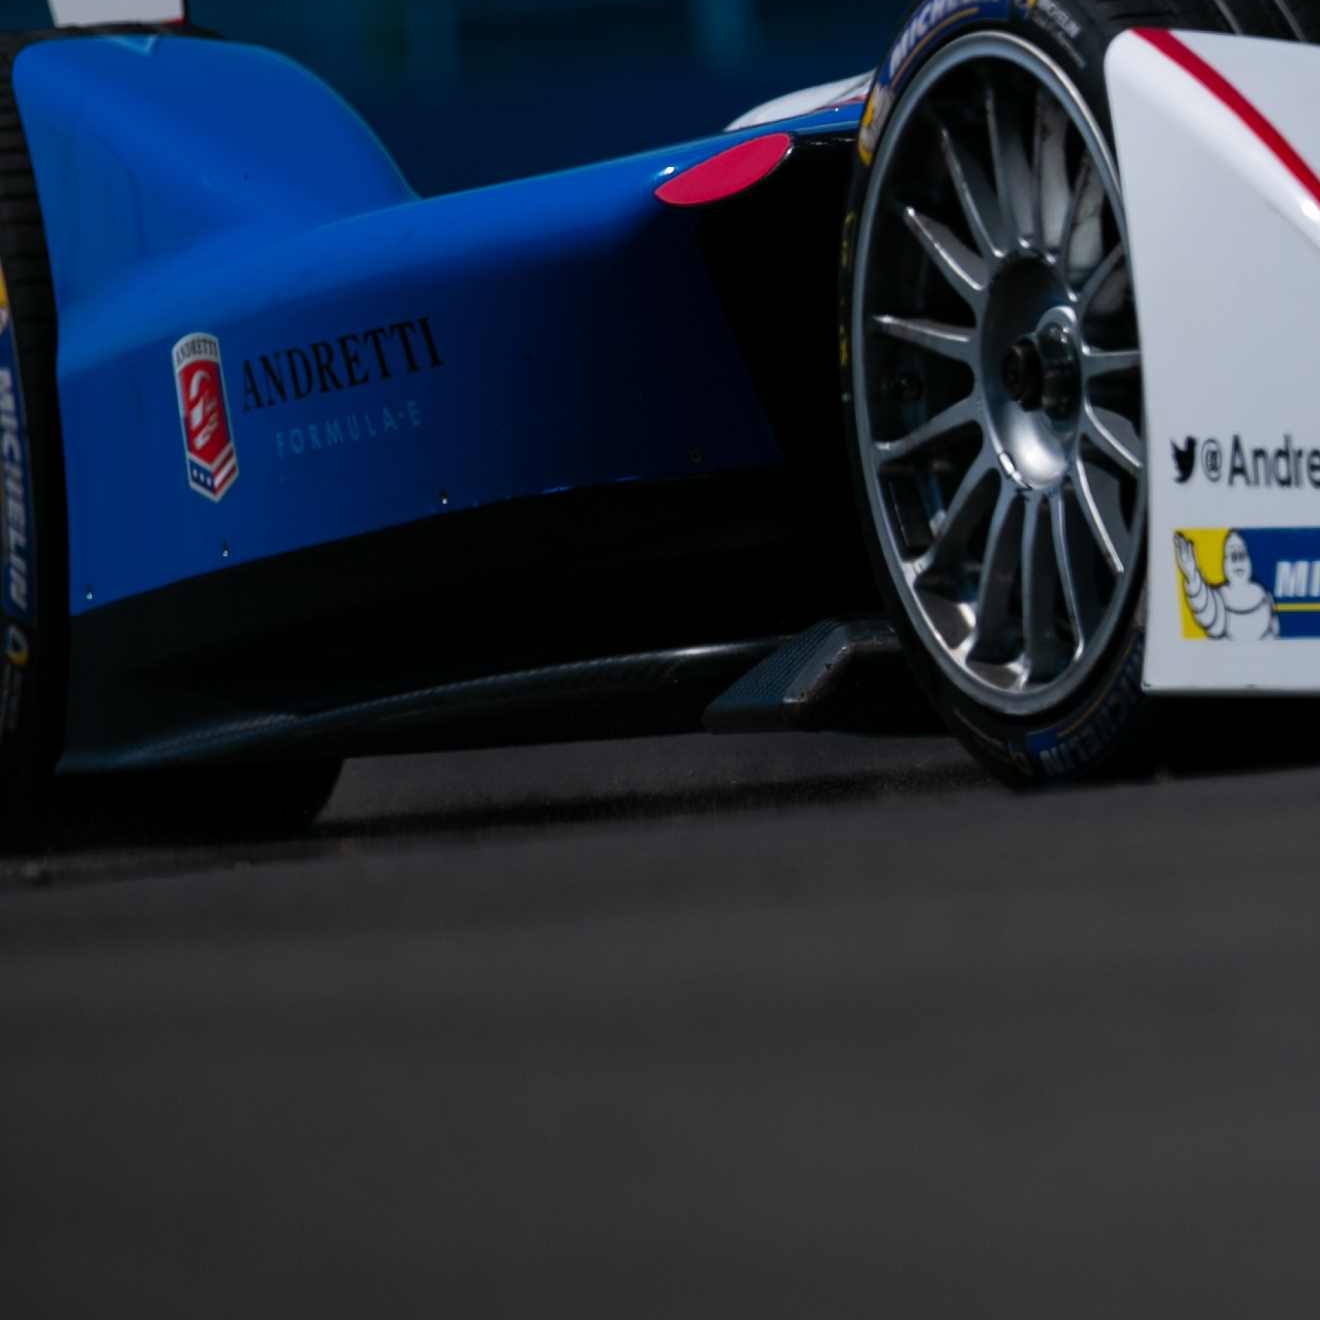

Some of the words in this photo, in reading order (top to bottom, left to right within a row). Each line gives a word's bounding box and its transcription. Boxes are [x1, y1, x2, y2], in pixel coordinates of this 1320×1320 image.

[176, 337, 219, 366] ANDRETTI
[243, 316, 444, 412] ANDRETTI
[275, 400, 422, 458] FORMULA-E
